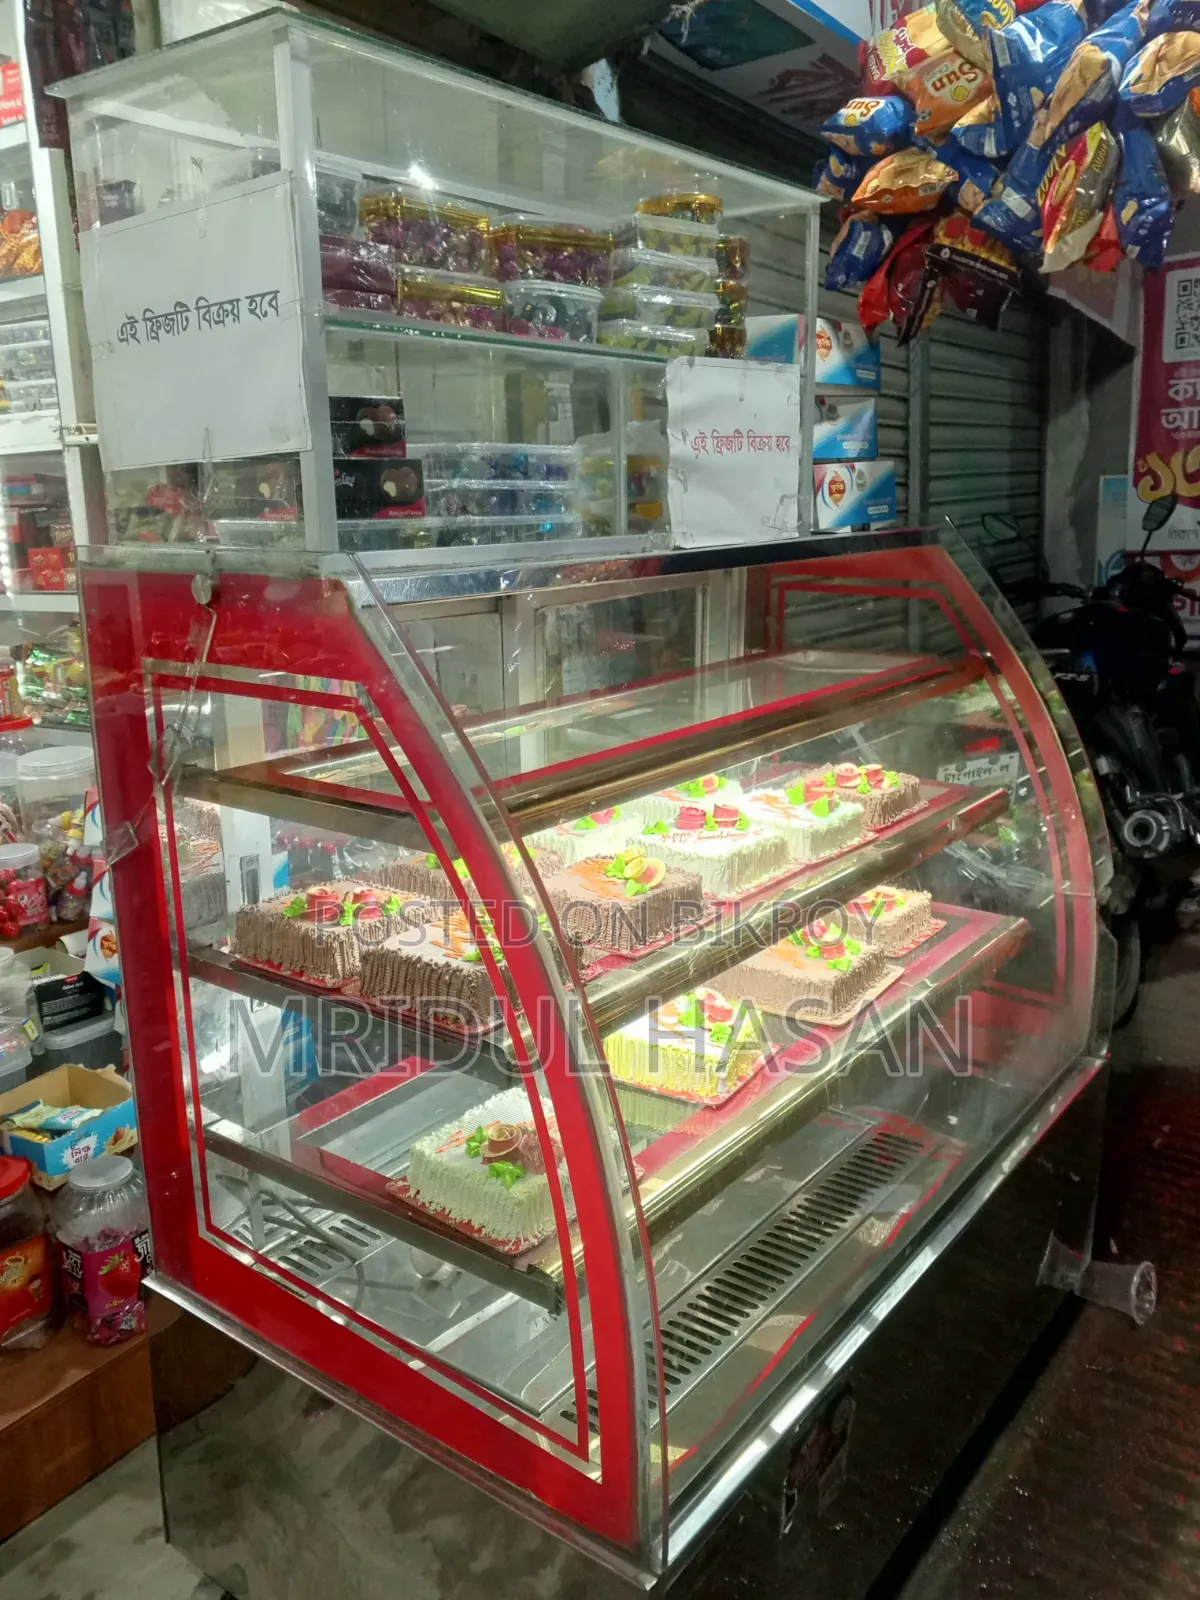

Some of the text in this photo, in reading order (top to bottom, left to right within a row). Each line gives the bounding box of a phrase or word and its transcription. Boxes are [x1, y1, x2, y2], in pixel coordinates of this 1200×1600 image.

[931, 62, 979, 92] Sun
[116, 289, 281, 346] এই ফ্রিজটি বিক্রয় হবে
[691, 428, 791, 457] এই ফ্রিজটি বিক্রয় হবে
